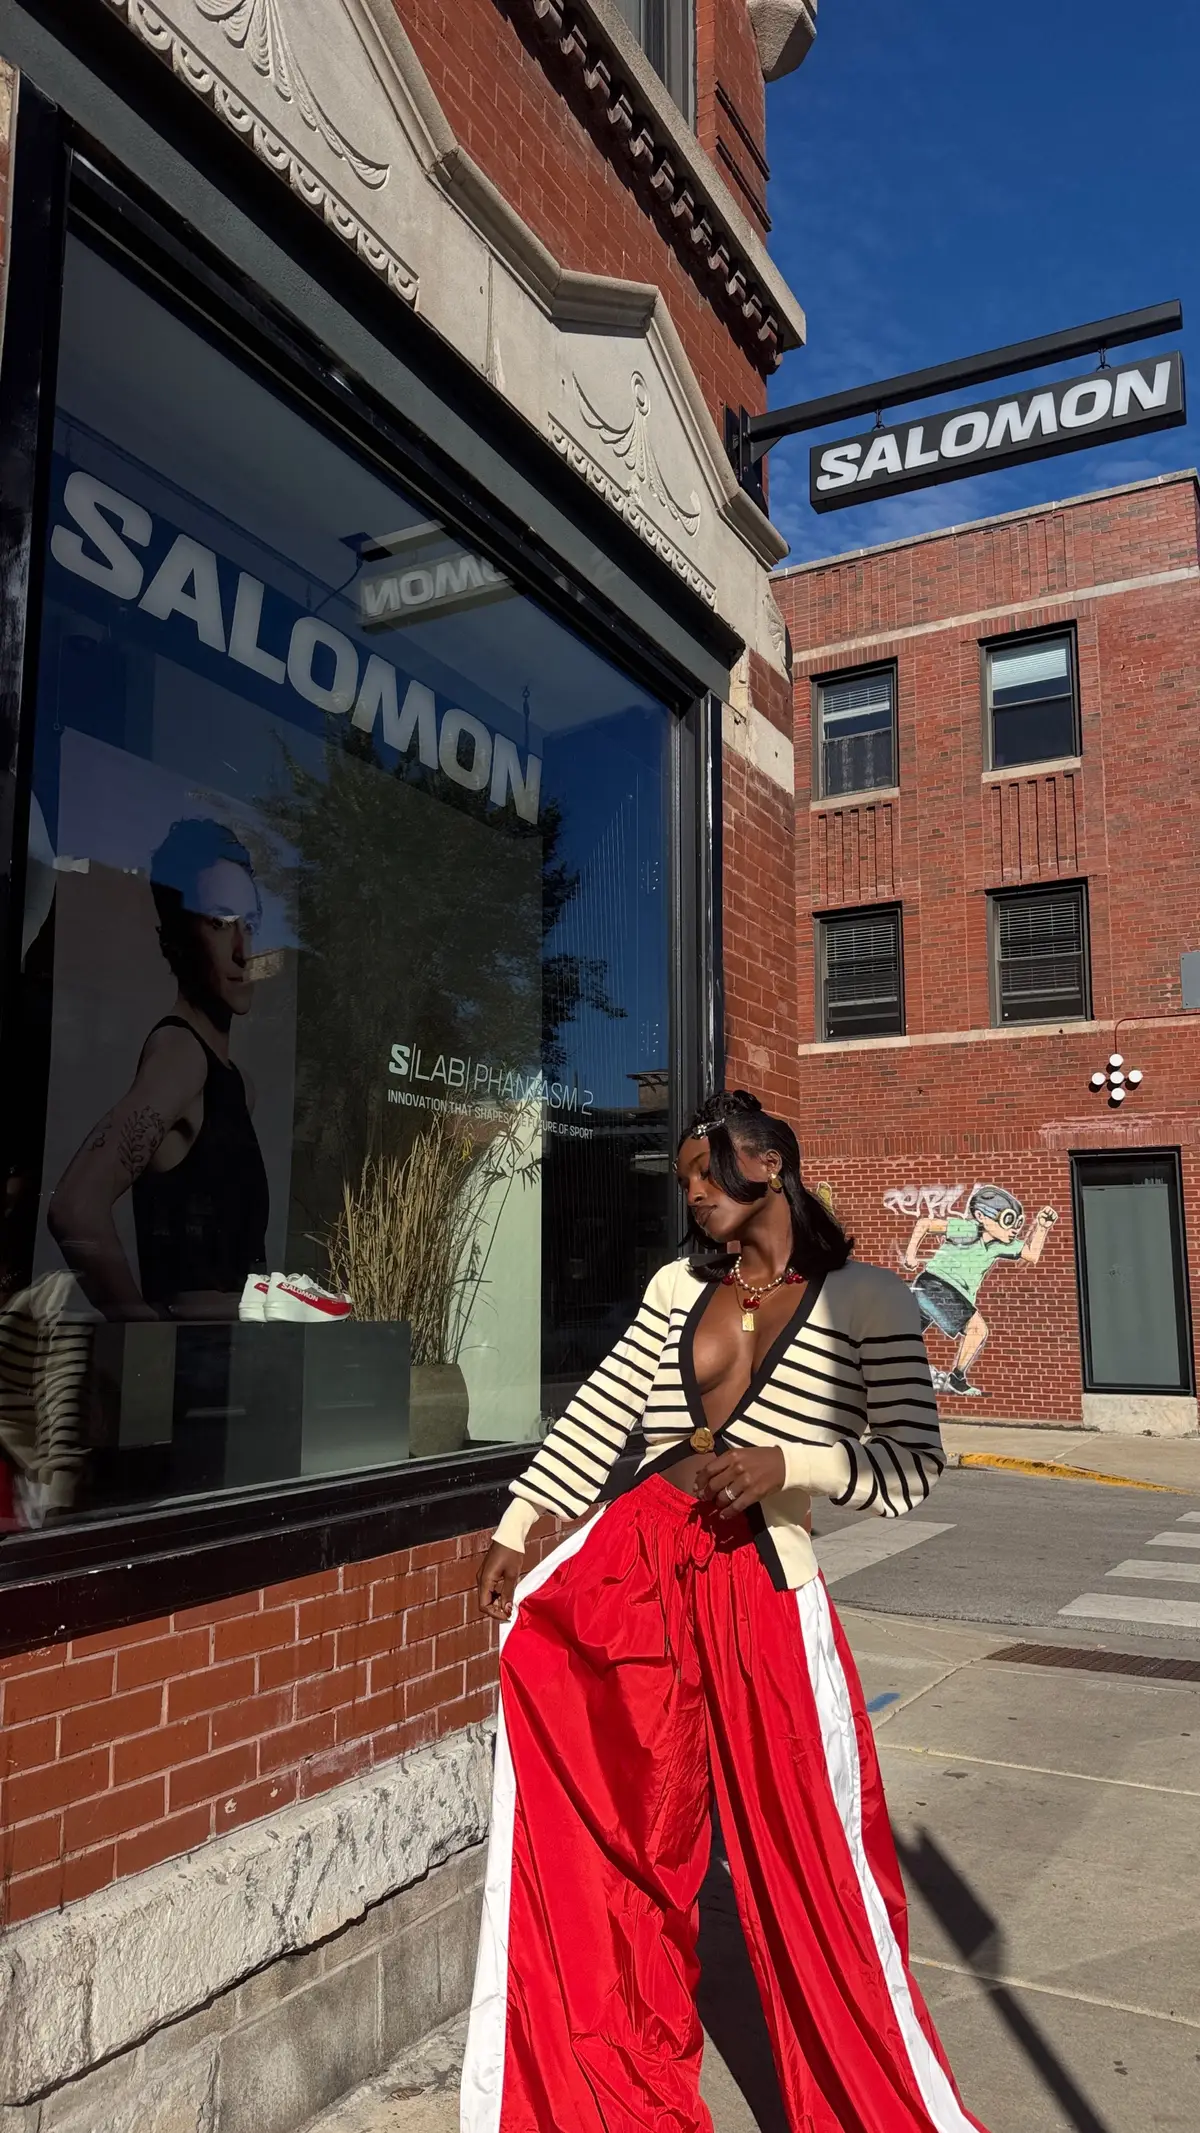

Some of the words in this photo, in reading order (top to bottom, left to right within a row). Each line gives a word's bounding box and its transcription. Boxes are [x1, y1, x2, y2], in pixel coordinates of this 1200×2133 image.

[816, 360, 1171, 491] SALOMON
[50, 470, 543, 825] SALOMON
[387, 1089, 447, 1112] INNOVATION
[449, 1101, 472, 1117] THAT
[474, 1106, 509, 1124] SHAPES
[559, 1123, 569, 1135] OF
[569, 1125, 594, 1140] SPORT
[581, 1090, 594, 1116] 2
[280, 1282, 319, 1302] SALOMON
